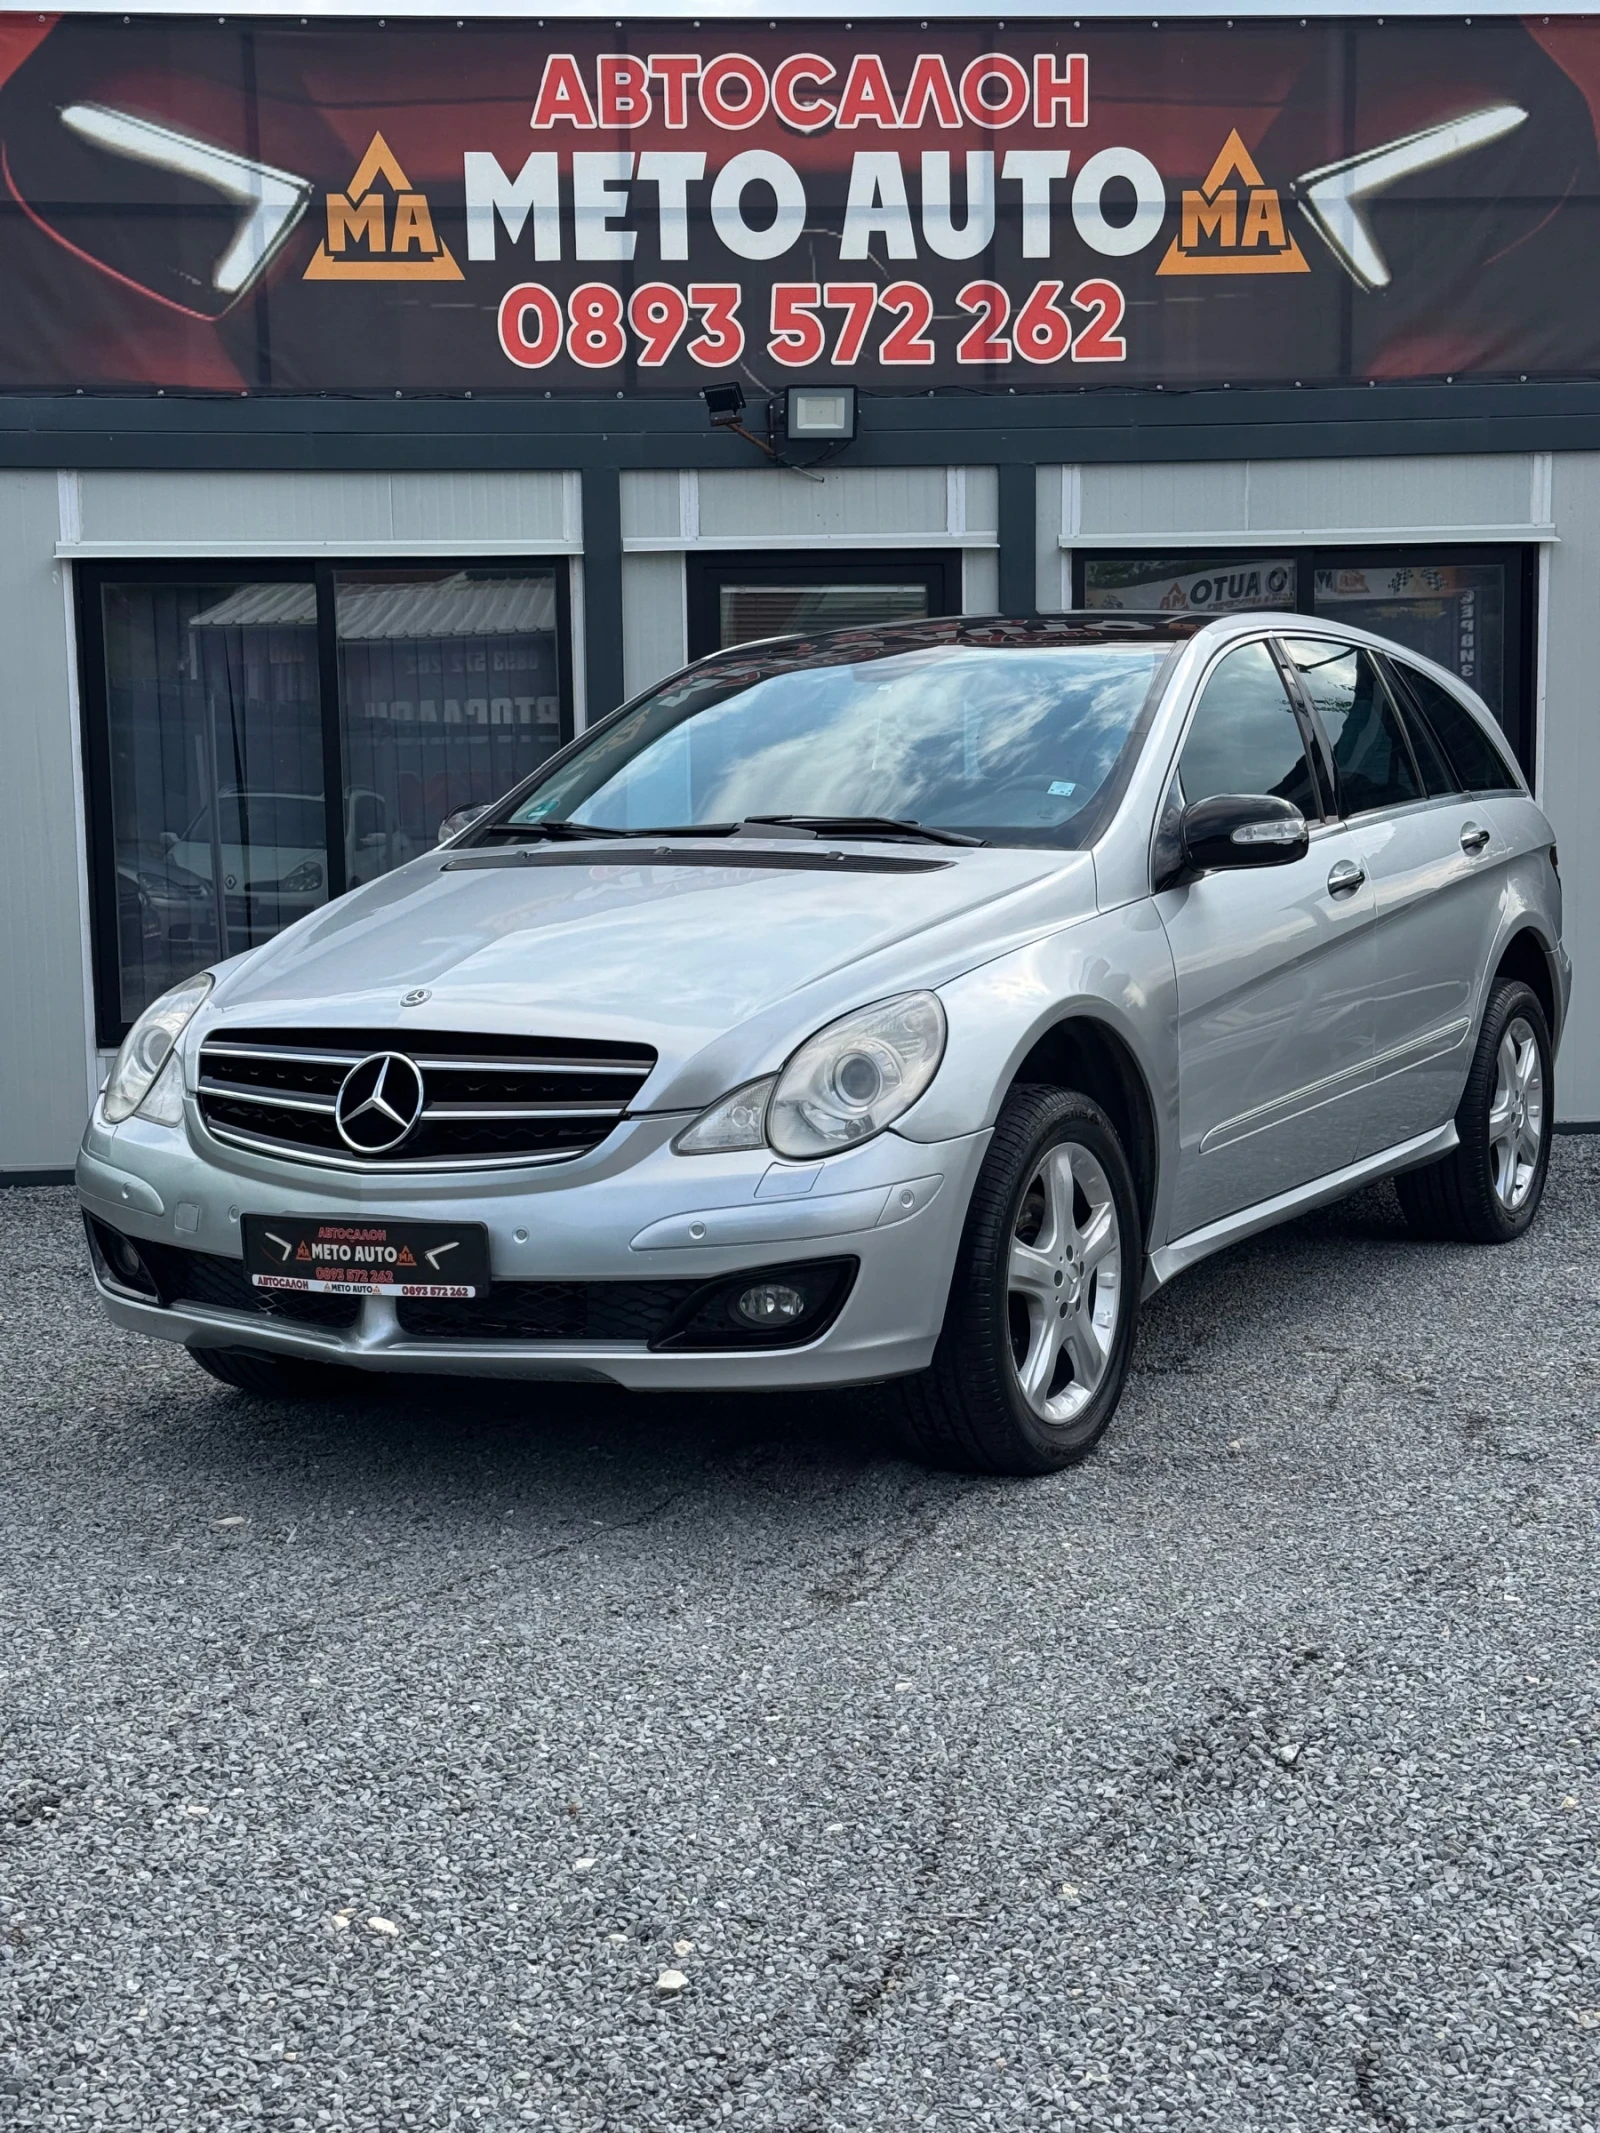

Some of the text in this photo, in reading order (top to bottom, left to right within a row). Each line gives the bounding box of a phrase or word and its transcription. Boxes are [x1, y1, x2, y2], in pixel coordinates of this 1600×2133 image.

[530, 53, 1089, 130] АВТОСАЛОН
[464, 147, 1166, 262] METO AUTO
[326, 193, 438, 252] MA
[1182, 189, 1287, 247] MA
[498, 278, 1127, 369] 0893 572 262
[318, 1227, 387, 1241] АВТОСАЛОН
[311, 1243, 397, 1263] METO AUTO
[257, 1276, 309, 1290] АВТОСАЛОН
[315, 1267, 394, 1284] 0893 572 262
[331, 1284, 351, 1293] METO
[352, 1285, 373, 1294] AUTO
[402, 1286, 469, 1297] 0893 572 262
